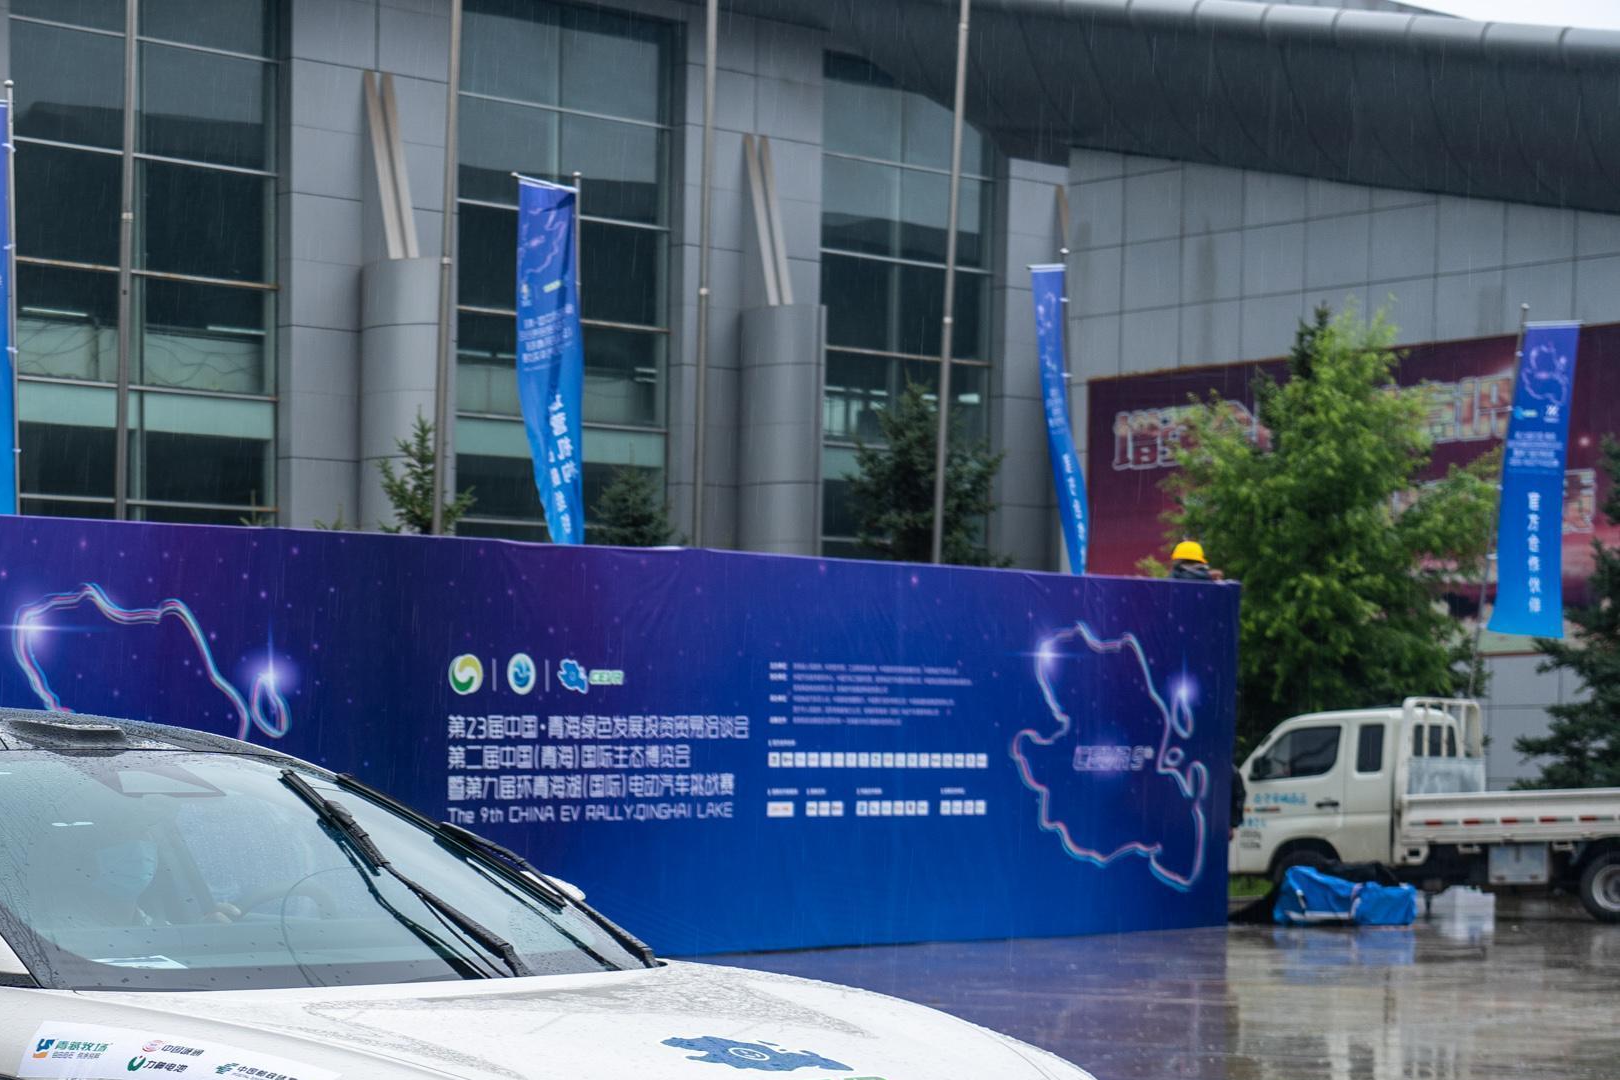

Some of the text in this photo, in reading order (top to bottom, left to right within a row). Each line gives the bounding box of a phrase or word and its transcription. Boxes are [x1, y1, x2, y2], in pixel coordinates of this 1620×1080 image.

[447, 807, 475, 824] The
[480, 806, 504, 823] 9th
[508, 805, 555, 823] CHINA
[560, 805, 580, 822] EV
[696, 801, 733, 819] LAKE
